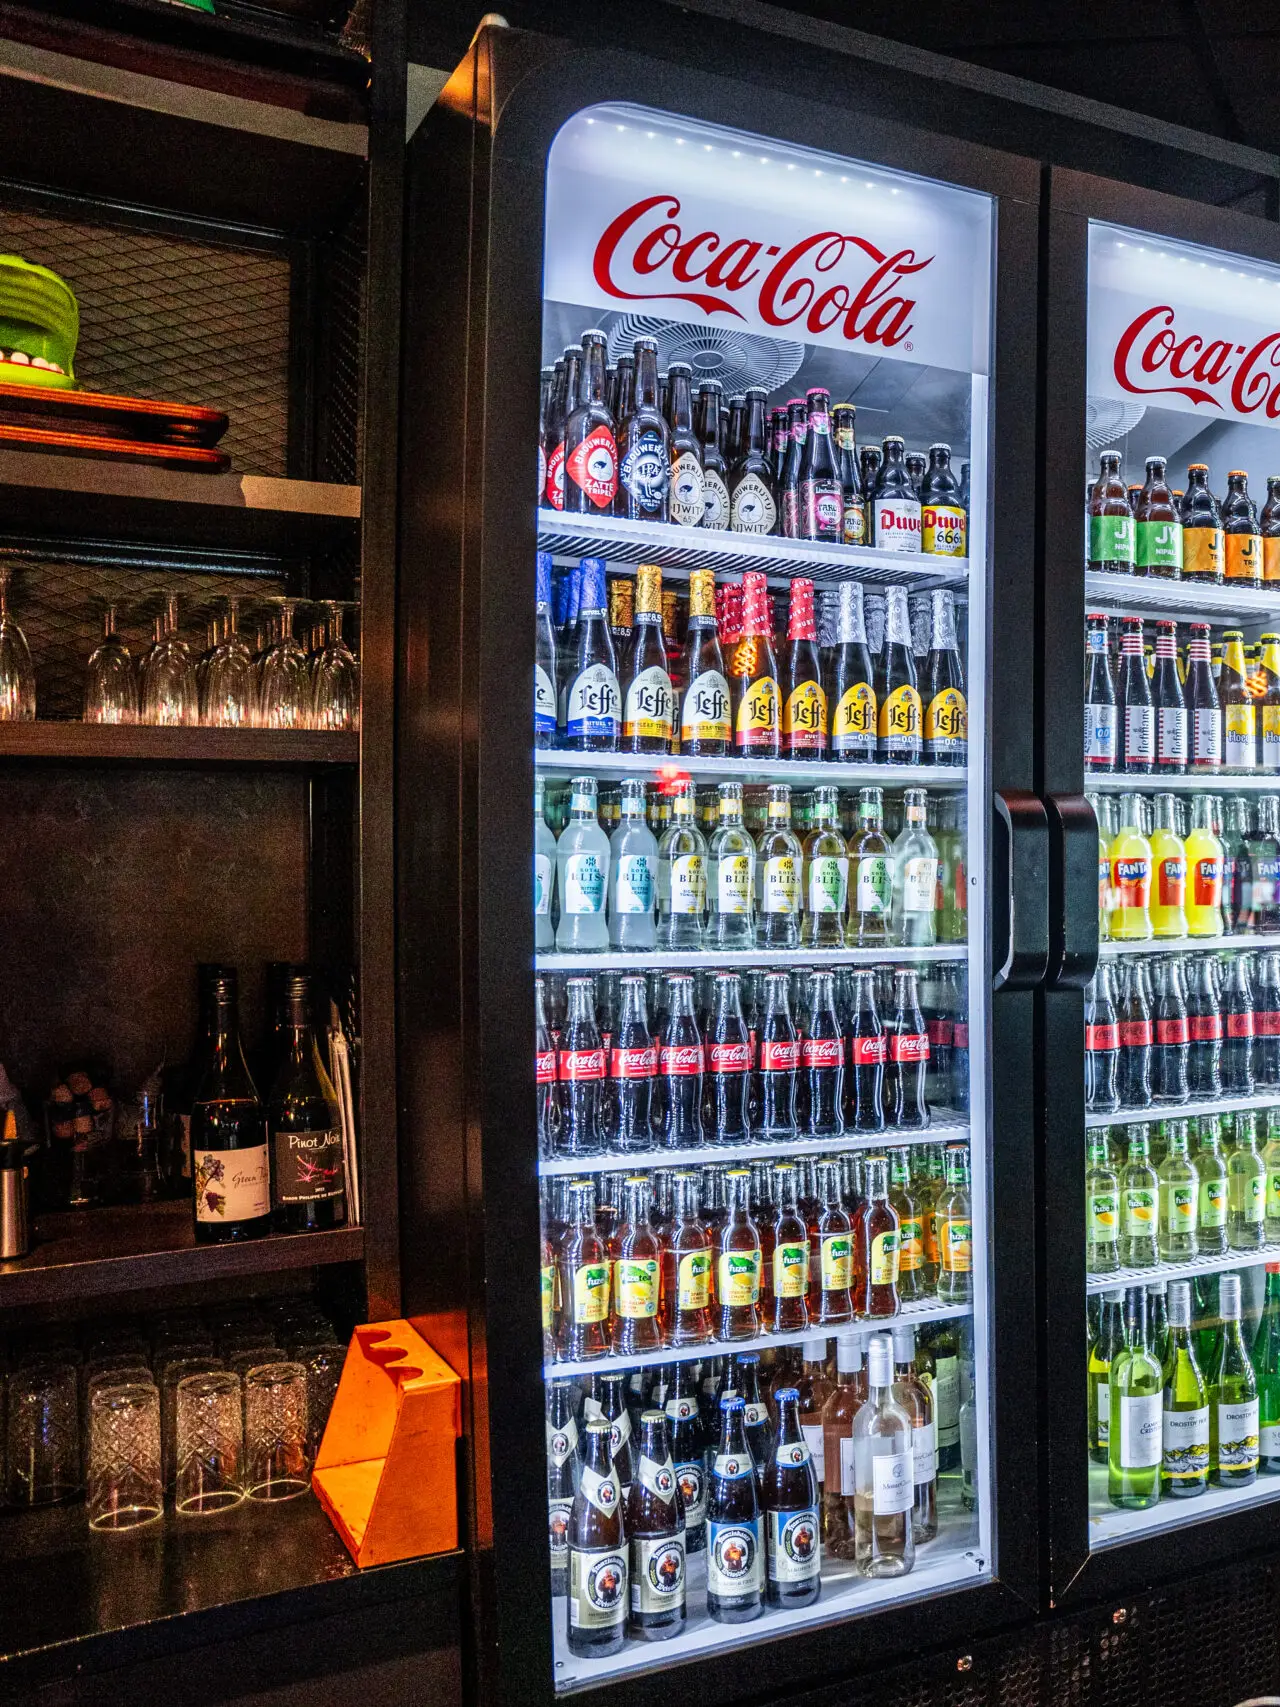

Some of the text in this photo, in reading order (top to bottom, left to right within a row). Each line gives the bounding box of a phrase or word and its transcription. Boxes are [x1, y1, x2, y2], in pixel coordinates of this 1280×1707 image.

[593, 195, 936, 348] Coca-Cola
[584, 478, 615, 492] ZATTE
[587, 487, 613, 498] TRIPEL
[579, 683, 619, 716] Leffe
[635, 685, 672, 718] Leffe
[693, 689, 729, 720] Leffe
[749, 696, 782, 727] Leffe
[792, 699, 825, 728] Leffe
[844, 700, 876, 731] Leffe
[932, 706, 967, 736] Leffe
[287, 1135, 319, 1149] Pinot
[232, 1170, 257, 1189] Green
